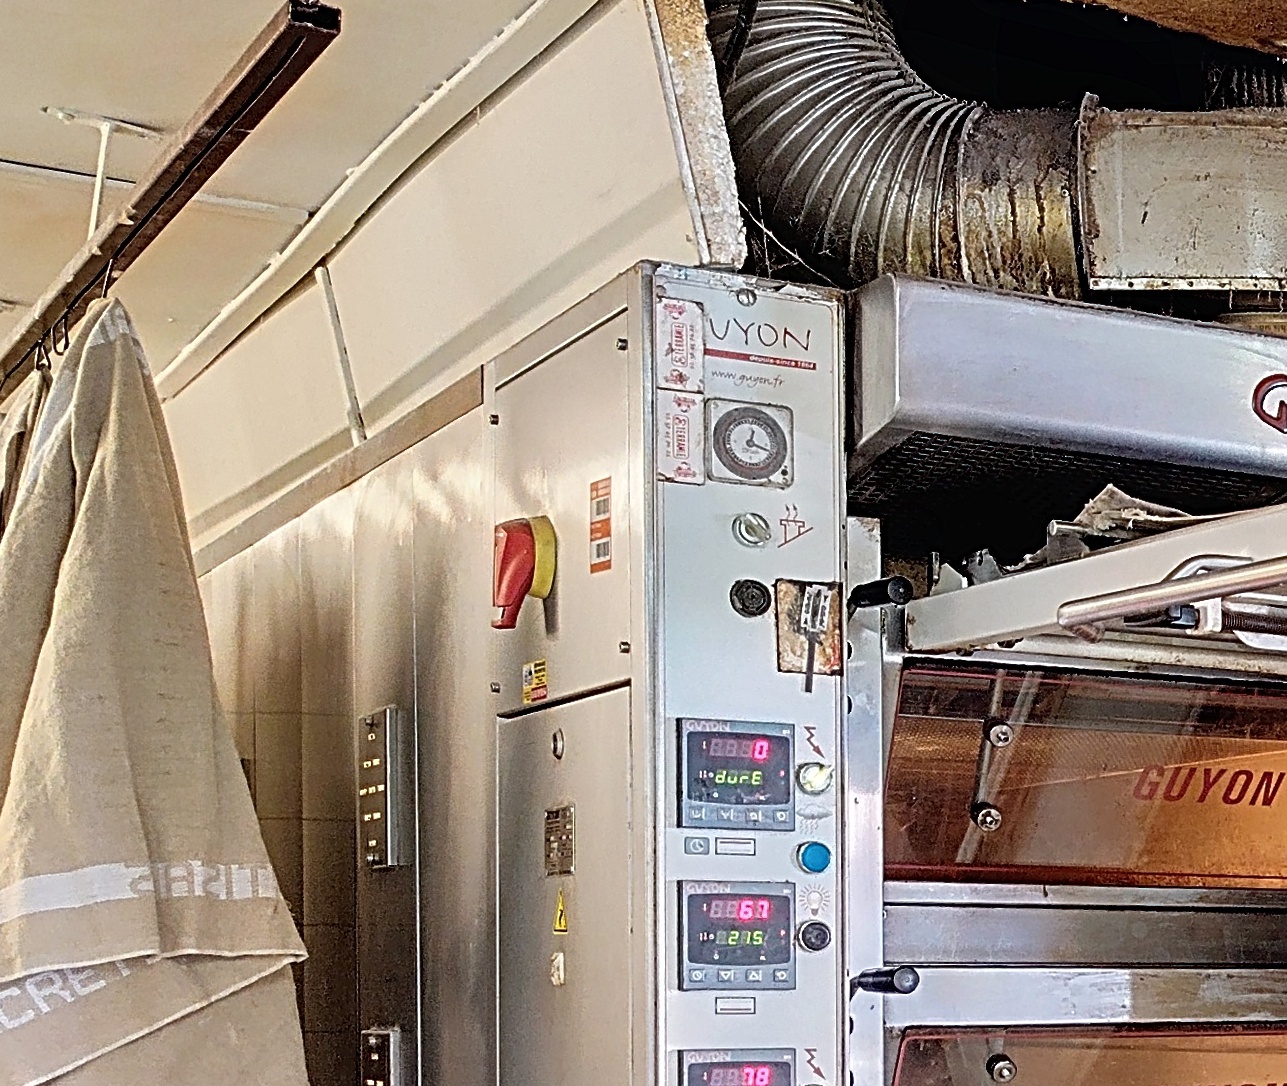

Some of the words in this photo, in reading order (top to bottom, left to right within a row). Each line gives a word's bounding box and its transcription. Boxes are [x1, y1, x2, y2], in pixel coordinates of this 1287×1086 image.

[710, 318, 811, 351] UYON
[711, 369, 785, 389] www.guyon.fr
[686, 720, 730, 732] GUYON
[1133, 763, 1286, 808] GUYON
[686, 883, 731, 893] GUYON
[739, 899, 770, 919] 67
[727, 931, 763, 945] 215
[687, 1052, 731, 1062] GUYON
[742, 1067, 769, 1086] 78
